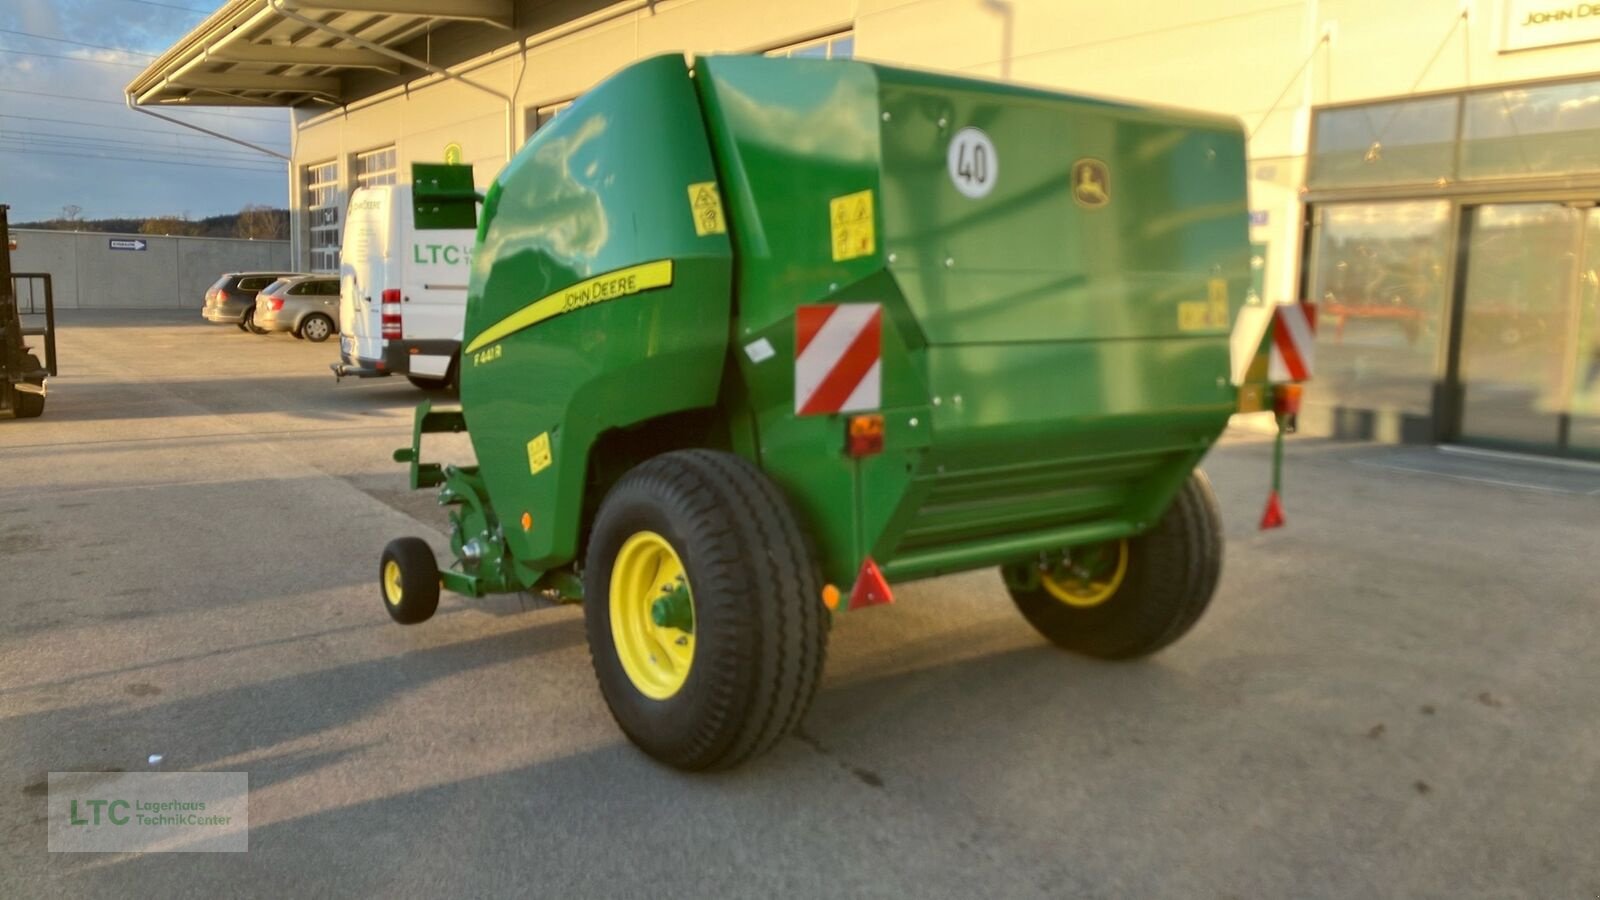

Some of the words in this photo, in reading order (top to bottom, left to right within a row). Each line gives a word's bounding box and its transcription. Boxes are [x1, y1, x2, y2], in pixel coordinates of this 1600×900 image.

[1522, 9, 1573, 26] JOHN
[958, 143, 987, 183] 40
[413, 244, 460, 265] LTC
[562, 287, 590, 309] JOHN
[592, 275, 636, 299] DEERE
